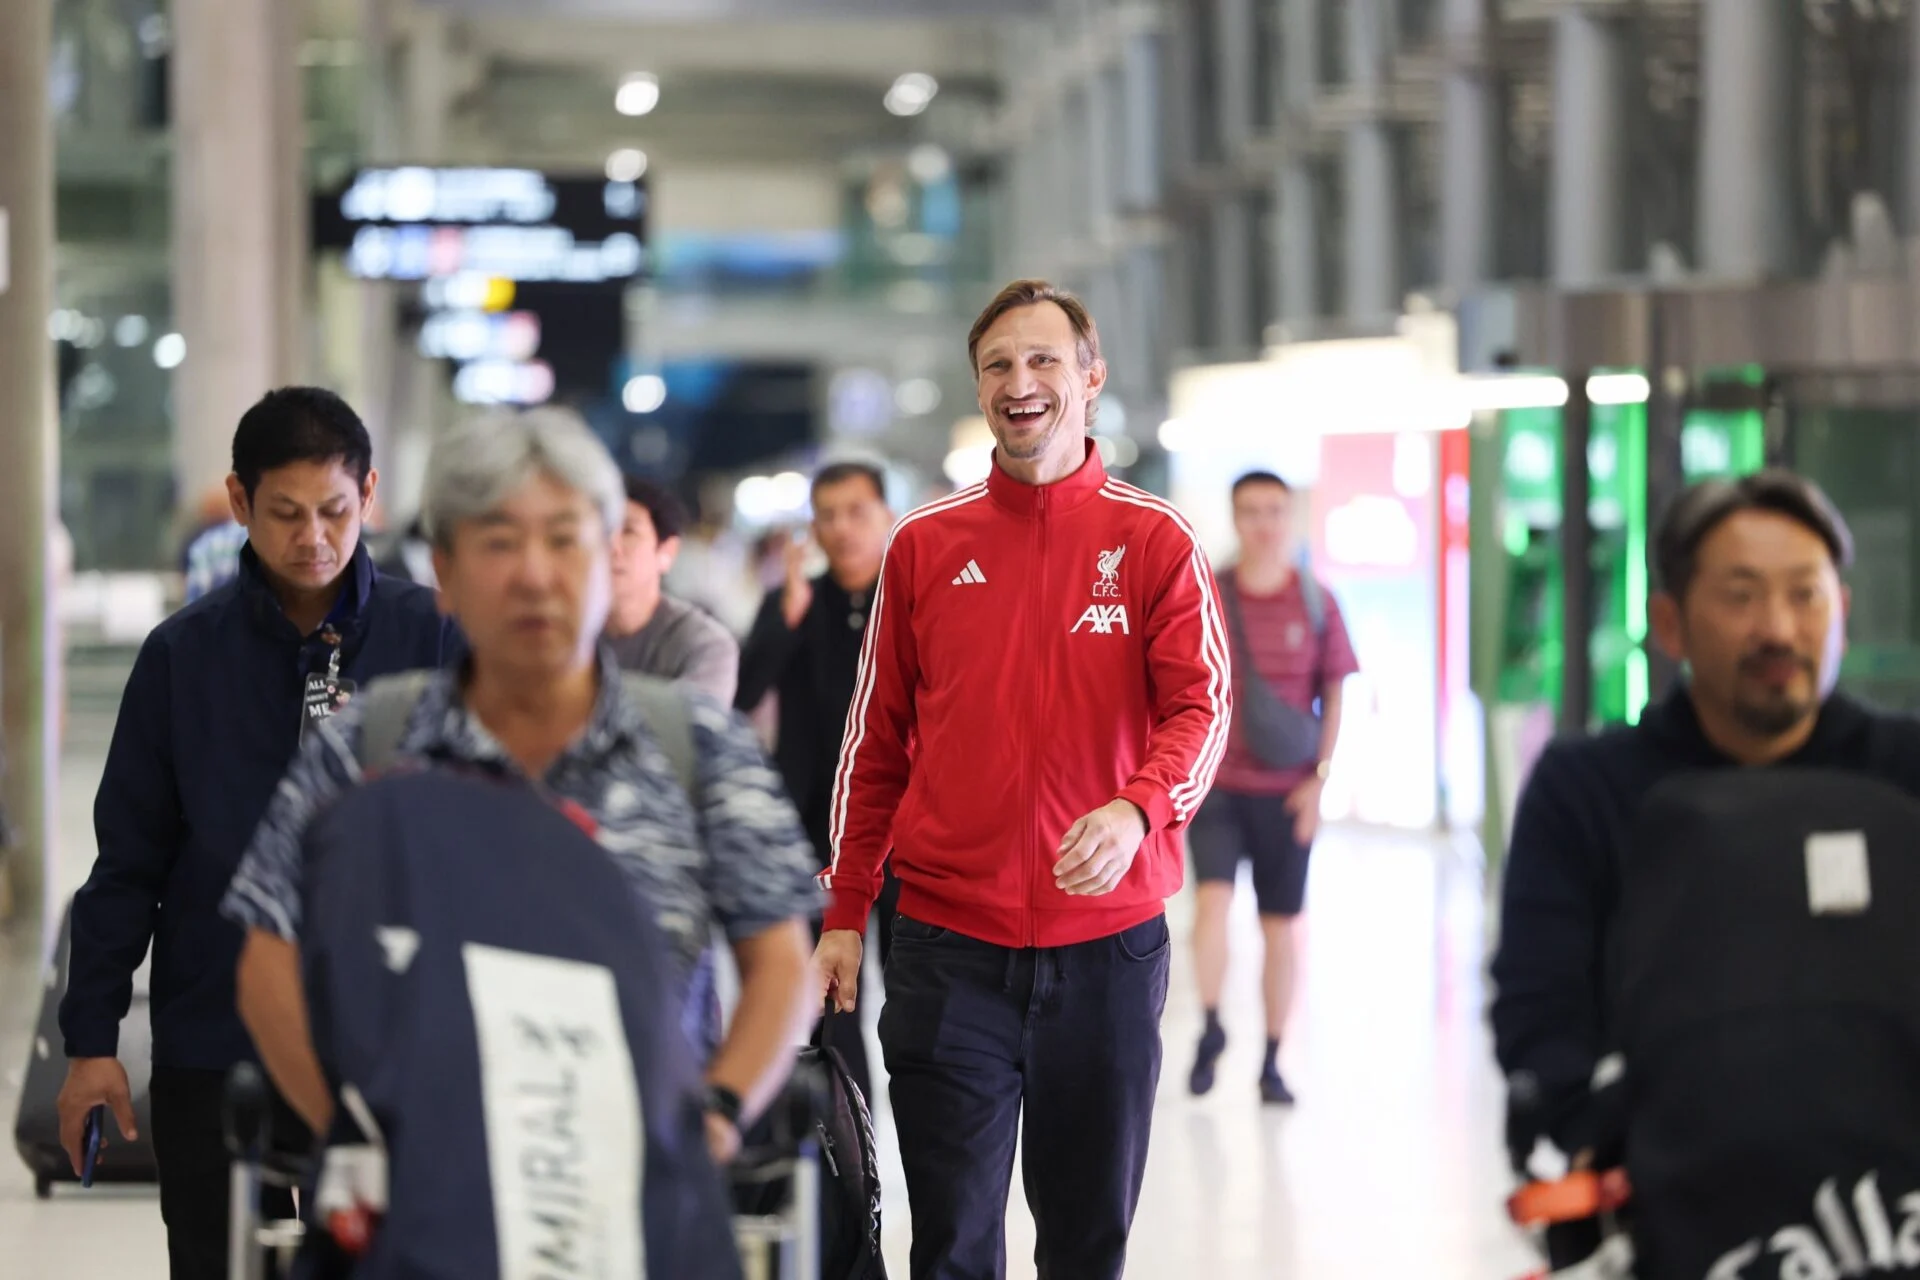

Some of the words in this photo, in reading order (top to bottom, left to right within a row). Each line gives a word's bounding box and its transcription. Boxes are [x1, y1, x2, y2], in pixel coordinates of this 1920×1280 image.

[1092, 584, 1122, 597] L.F.C.
[1070, 605, 1130, 635] AXA
[308, 680, 327, 691] ALL
[309, 702, 332, 717] ME
[515, 1065, 590, 1280] MIRAL
